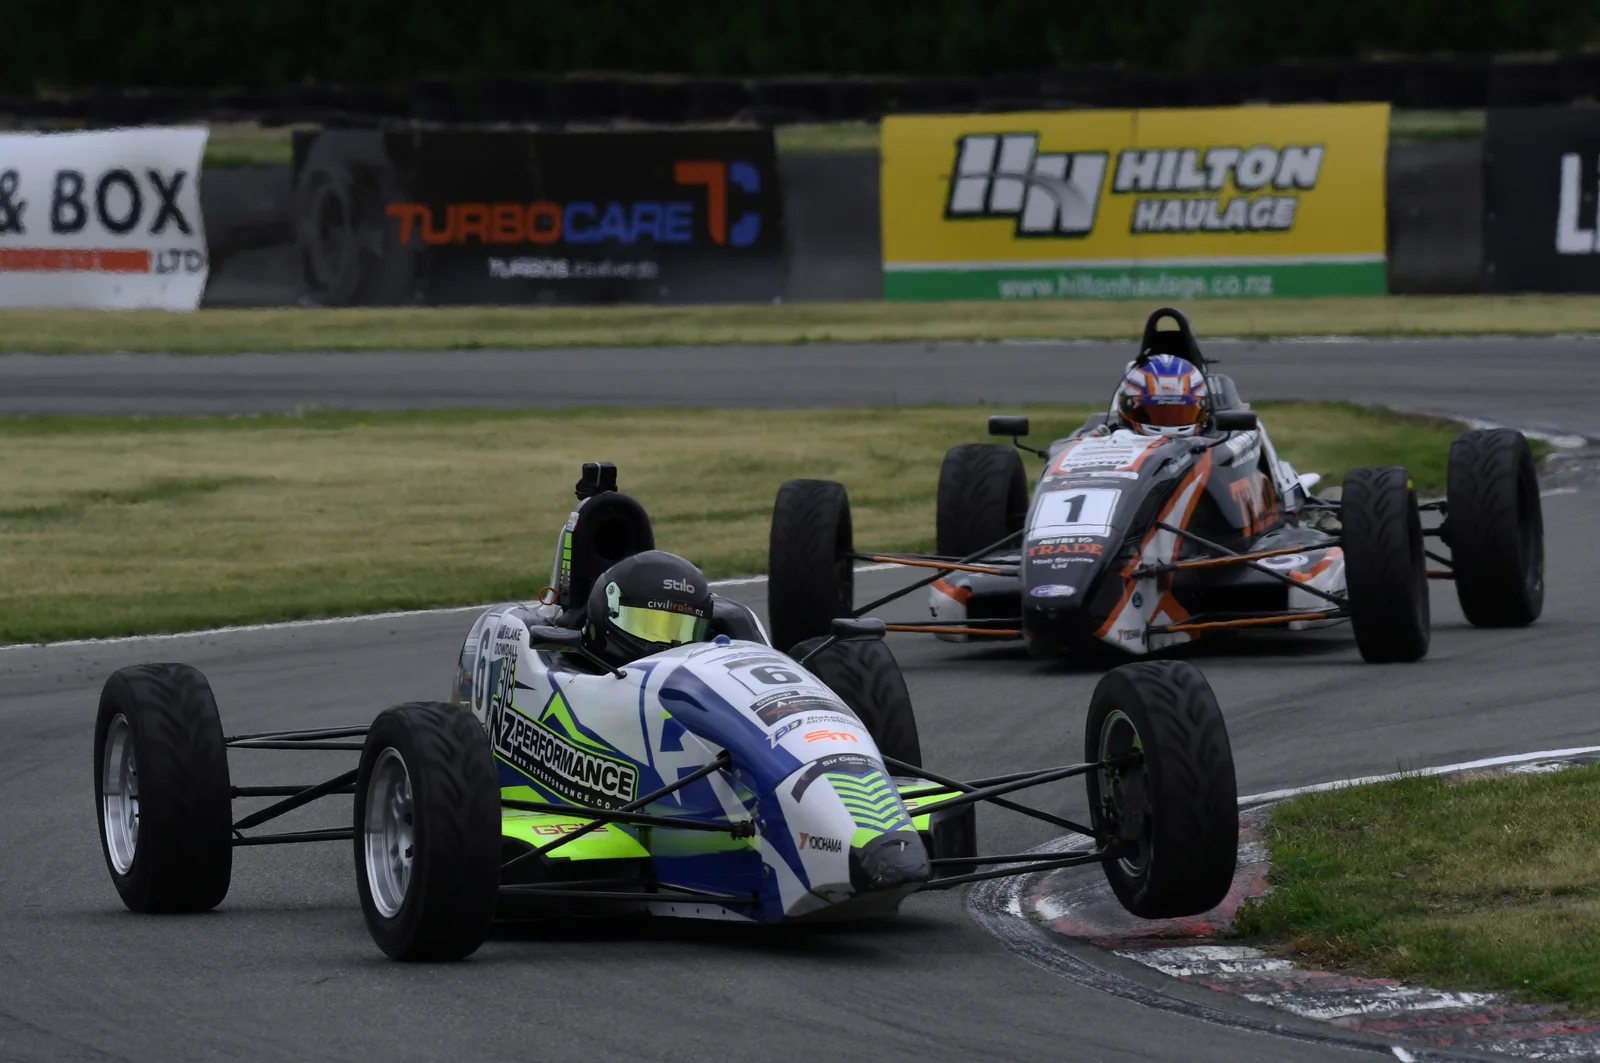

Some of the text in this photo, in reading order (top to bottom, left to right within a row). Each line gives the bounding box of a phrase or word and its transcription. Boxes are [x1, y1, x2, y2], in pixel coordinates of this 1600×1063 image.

[1113, 143, 1326, 193] HILTON
[50, 167, 193, 236] BOX
[385, 202, 695, 246] TURBOCARE
[1132, 196, 1298, 234] HAULAGE
[1063, 494, 1087, 523] 1
[1026, 543, 1105, 557] TRADE
[663, 577, 695, 595] Stilo
[647, 599, 704, 618] civiltrain.nz
[503, 626, 524, 642] BLAKE
[493, 642, 519, 658] DOWDALL
[749, 665, 803, 685] 6
[822, 758, 838, 767] Sir
[808, 836, 842, 854] YOKOHAMA
